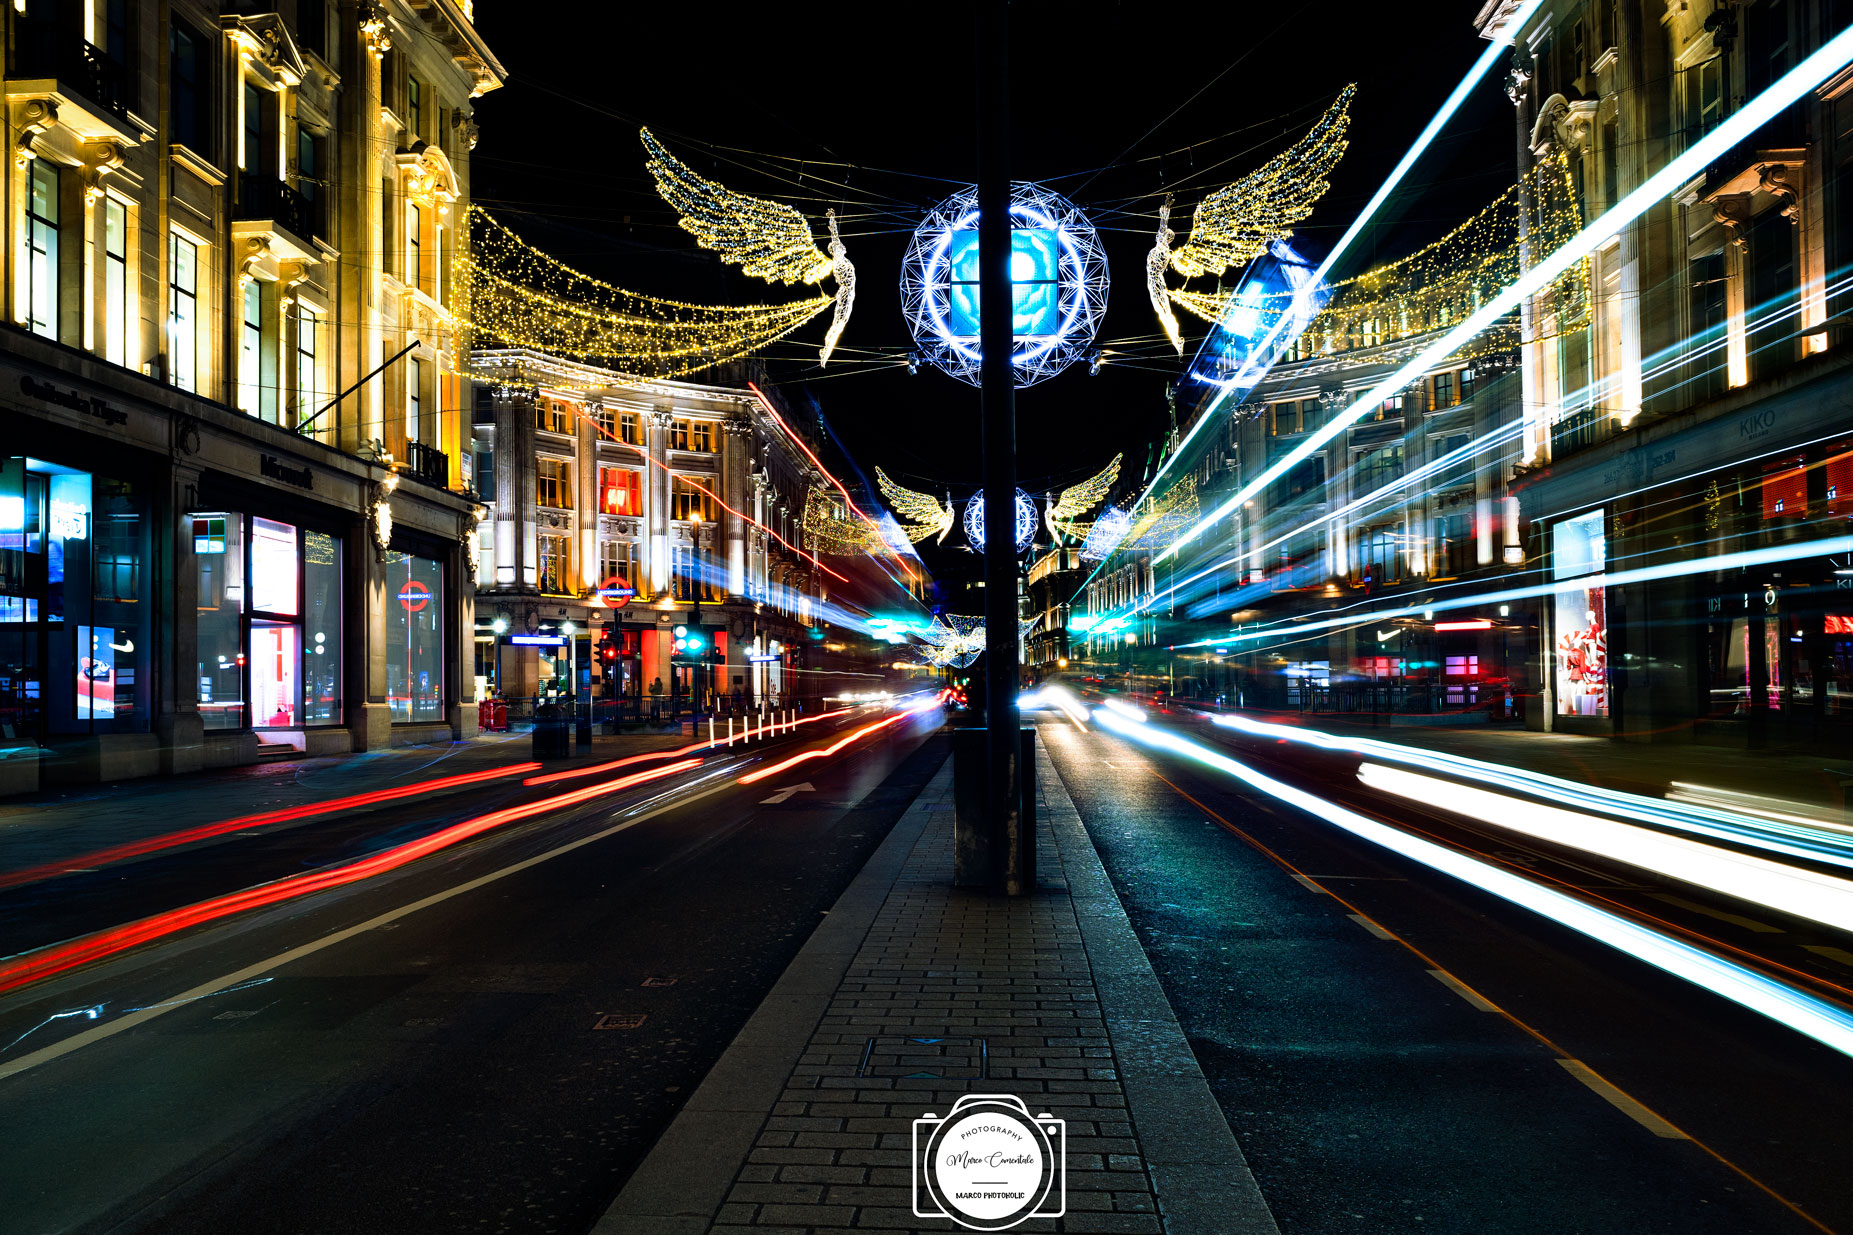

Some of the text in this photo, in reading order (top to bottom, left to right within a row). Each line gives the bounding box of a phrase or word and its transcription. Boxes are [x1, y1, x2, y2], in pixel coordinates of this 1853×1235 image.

[90, 397, 128, 425] Tiger
[1740, 410, 1775, 437] KIKO
[261, 454, 313, 490] Microsoft
